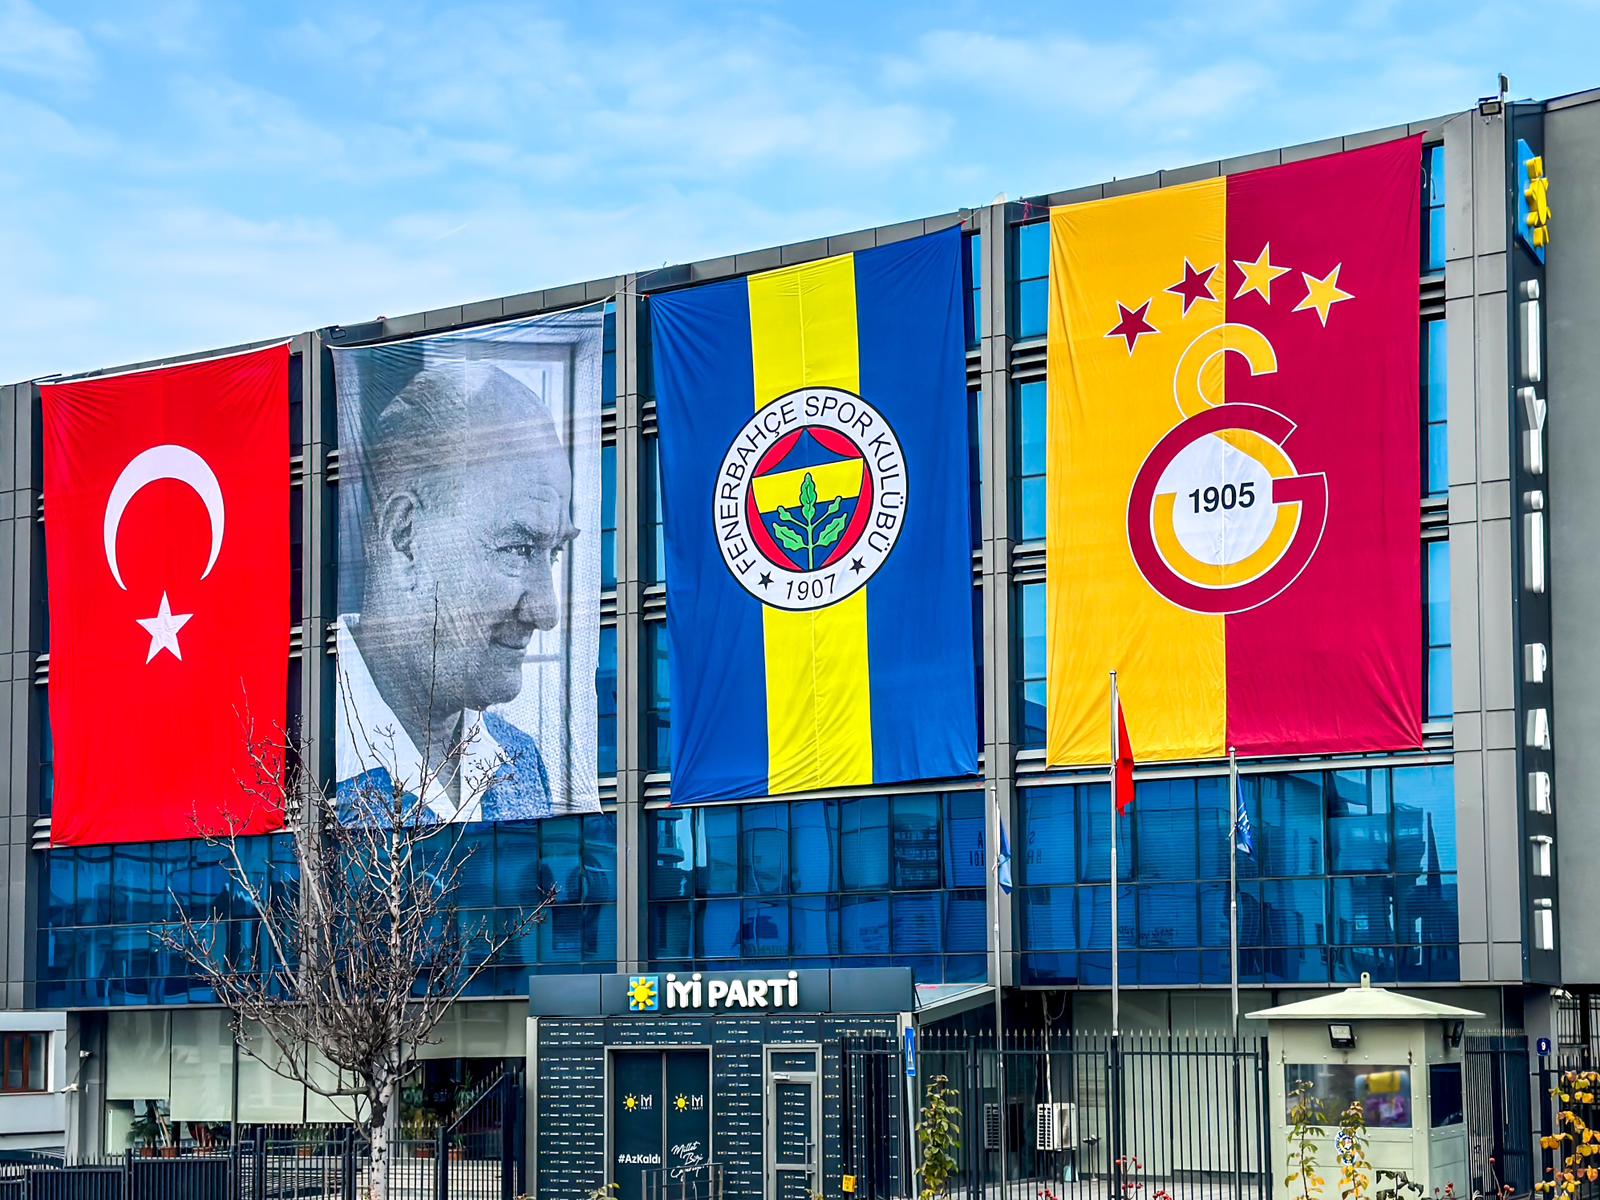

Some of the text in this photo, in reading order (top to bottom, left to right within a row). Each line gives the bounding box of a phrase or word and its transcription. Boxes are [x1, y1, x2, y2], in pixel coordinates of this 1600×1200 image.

[720, 395, 904, 576] FENERBAHÇE SPOR KULÜBÜ
[1188, 481, 1256, 514] 1905
[786, 573, 837, 601] 1907
[666, 970, 798, 1009] İYİ PARTİ
[618, 1153, 661, 1164] #AzKaldı
